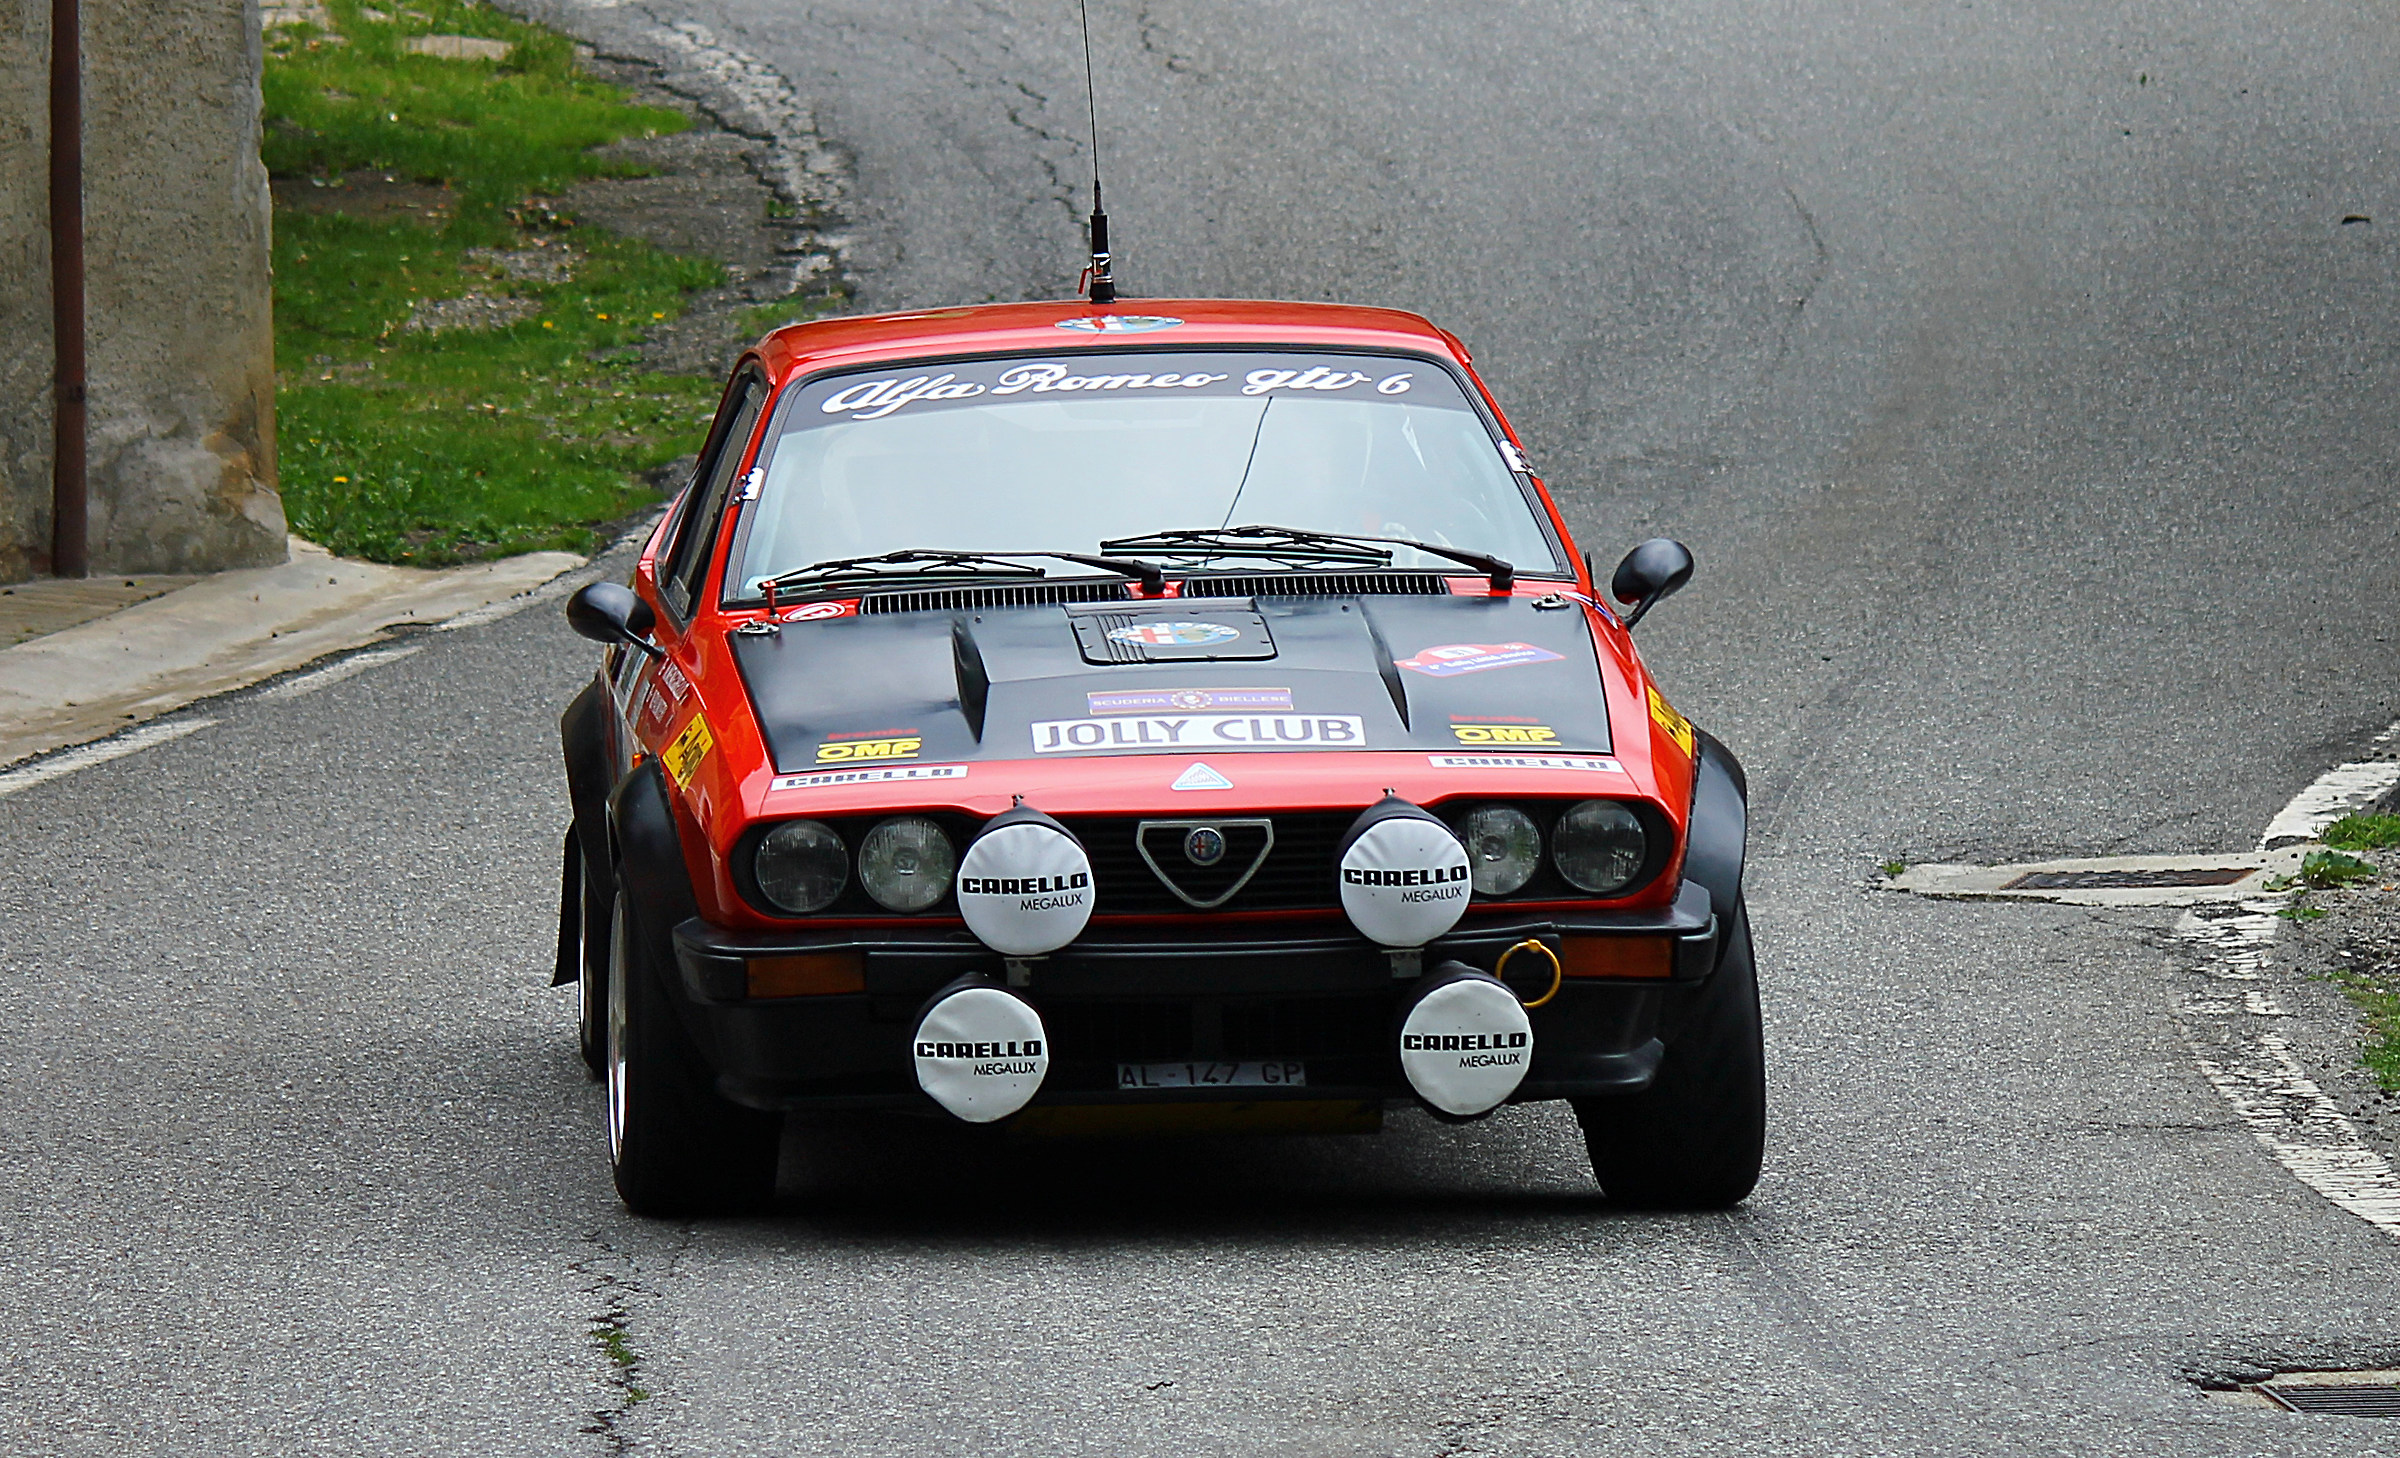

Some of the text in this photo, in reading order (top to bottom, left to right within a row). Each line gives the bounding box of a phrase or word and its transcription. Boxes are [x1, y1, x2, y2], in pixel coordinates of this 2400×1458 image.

[820, 362, 1414, 420] Alfa Romeo gtv 6
[1093, 697, 1166, 707] SCUDERIA
[1219, 695, 1290, 703] BIELLESE
[1043, 719, 1356, 748] JOLLY CLUB
[1454, 728, 1556, 742] OMP
[816, 741, 921, 759] OMP
[1444, 757, 1610, 770] CARELLO
[785, 768, 953, 787] CARELLO
[962, 872, 1089, 895] CARELLO
[1343, 865, 1468, 887] CARELLO
[1020, 893, 1083, 911] MEGALUX
[1401, 886, 1463, 903] MEGALUX
[916, 1040, 1042, 1058] CARELLO
[1403, 1032, 1527, 1051] CARELLO
[973, 1062, 1037, 1075] MEGALUX
[1459, 1053, 1521, 1068] MEGALUX
[1261, 1062, 1300, 1084] GP
